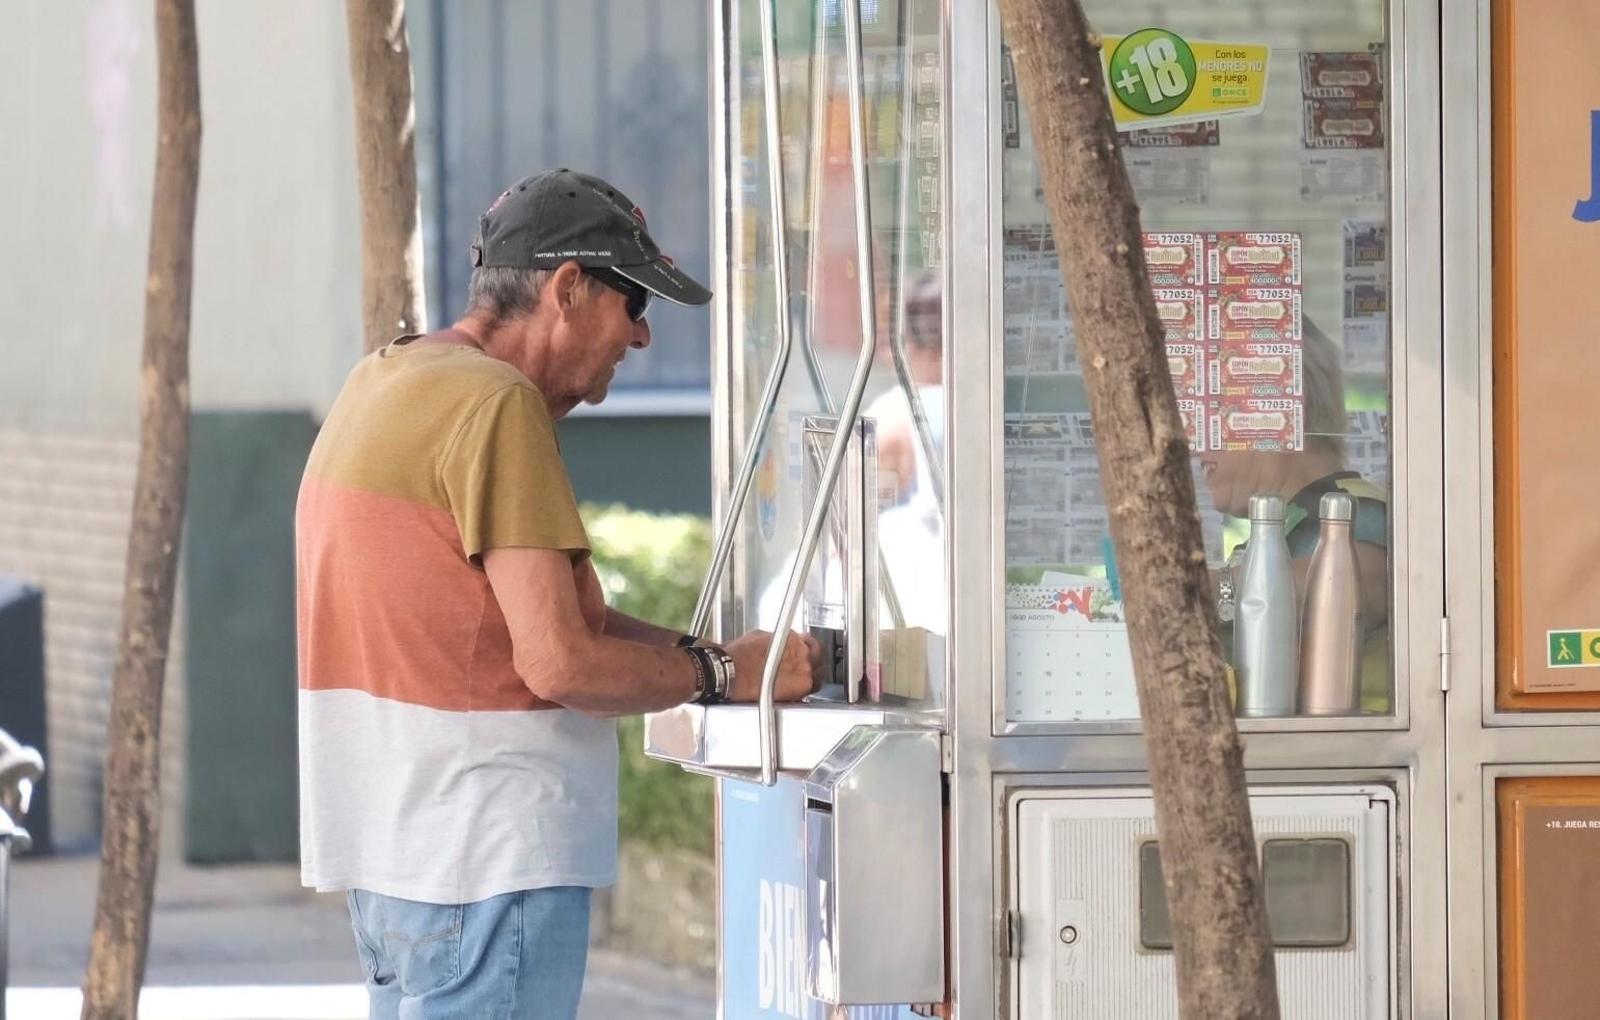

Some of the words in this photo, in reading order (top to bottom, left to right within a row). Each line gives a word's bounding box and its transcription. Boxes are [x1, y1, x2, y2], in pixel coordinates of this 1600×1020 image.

[1215, 50, 1232, 59] Con
[1233, 50, 1246, 59] los
[1115, 36, 1189, 104] +18
[1198, 60, 1246, 72] MENORES
[1249, 61, 1263, 72] NO
[1212, 74, 1222, 82] se
[1223, 73, 1250, 84] juega.
[1222, 89, 1248, 97] ONCE
[1161, 235, 1192, 243] 77052
[1259, 234, 1290, 243] 77052
[1162, 290, 1193, 298] 77052
[1260, 290, 1291, 298] 77052
[1167, 346, 1193, 354] 7052
[1260, 345, 1291, 353] 77052
[1261, 401, 1292, 409] 77052
